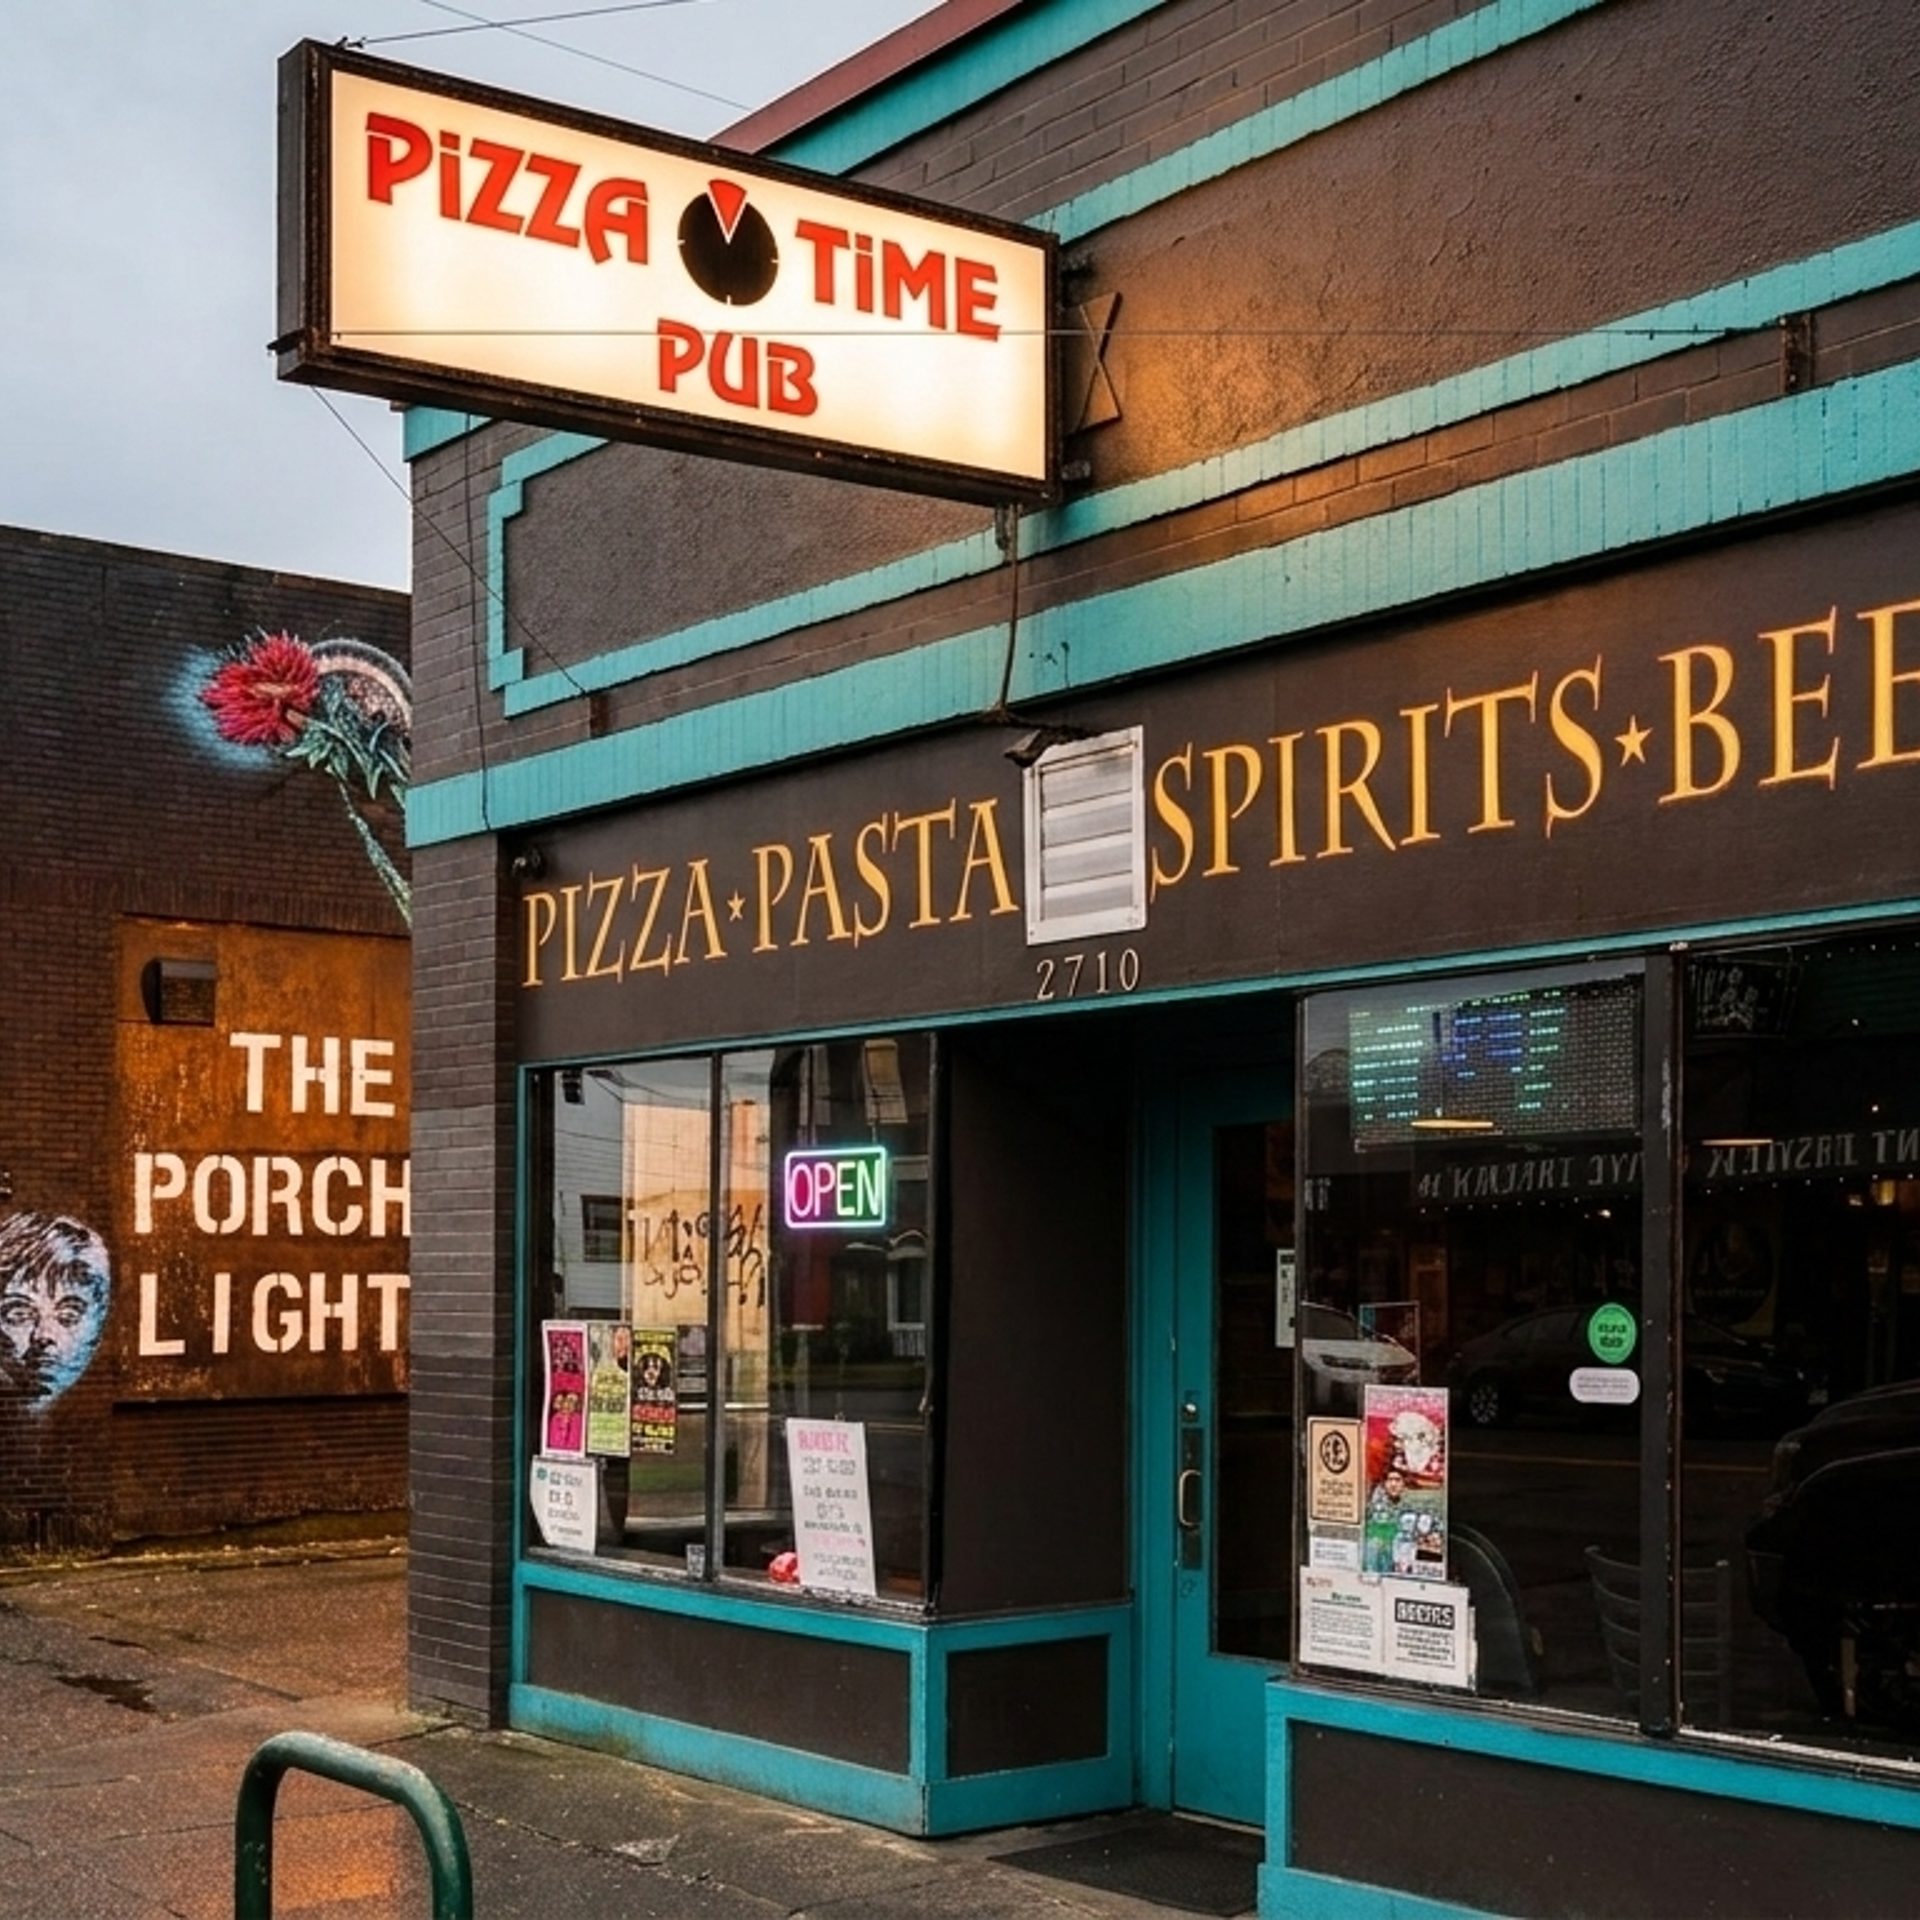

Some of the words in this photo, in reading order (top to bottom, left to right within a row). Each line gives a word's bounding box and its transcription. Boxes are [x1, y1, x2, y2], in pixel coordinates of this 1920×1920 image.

[657, 319, 818, 417] PUB
[522, 858, 727, 988] PIZZA
[751, 798, 1019, 949] PASTA
[1150, 654, 1602, 903] SPIRITS
[1036, 948, 1139, 1001] 2710
[229, 1031, 396, 1118] THE
[133, 1152, 410, 1237] PORCH
[791, 1160, 881, 1218] OPEN
[138, 1272, 410, 1356] LIGHT
